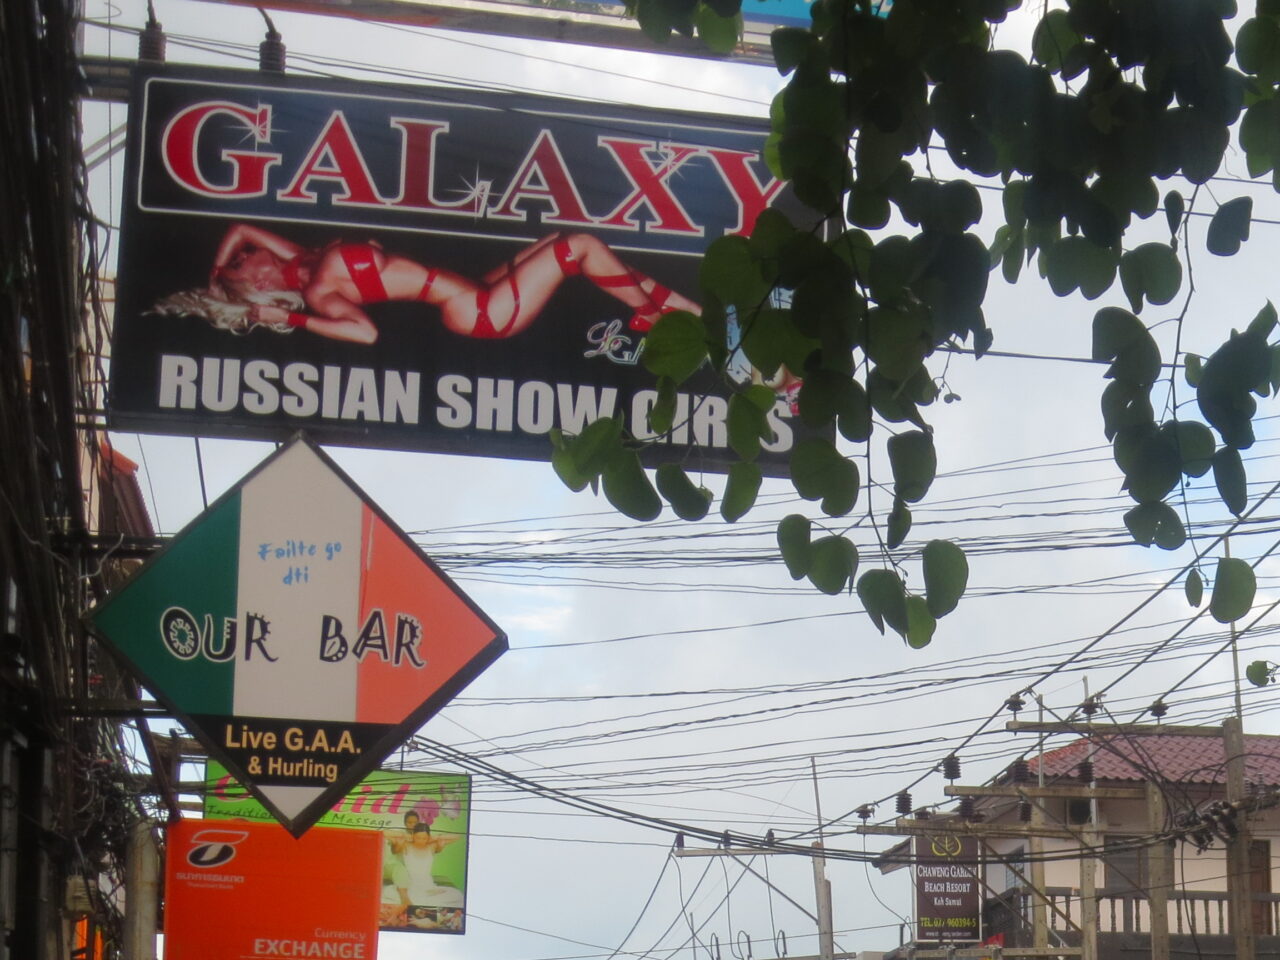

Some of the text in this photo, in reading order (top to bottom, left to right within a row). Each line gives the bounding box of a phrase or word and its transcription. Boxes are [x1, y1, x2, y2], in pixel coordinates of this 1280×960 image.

[161, 101, 790, 240] GALAXY
[158, 354, 793, 453] RUSSIAN SHOW GIRS
[324, 541, 342, 563] go
[159, 606, 427, 669] OUR BAR
[225, 724, 362, 755] Live G.A.A.
[248, 754, 339, 782] & Hurling
[332, 814, 393, 828] Massage
[917, 865, 949, 878] CHAWENG
[924, 882, 971, 893] BEACH RESORT
[314, 928, 366, 940] Currency
[254, 938, 365, 959] EXCHANGE
